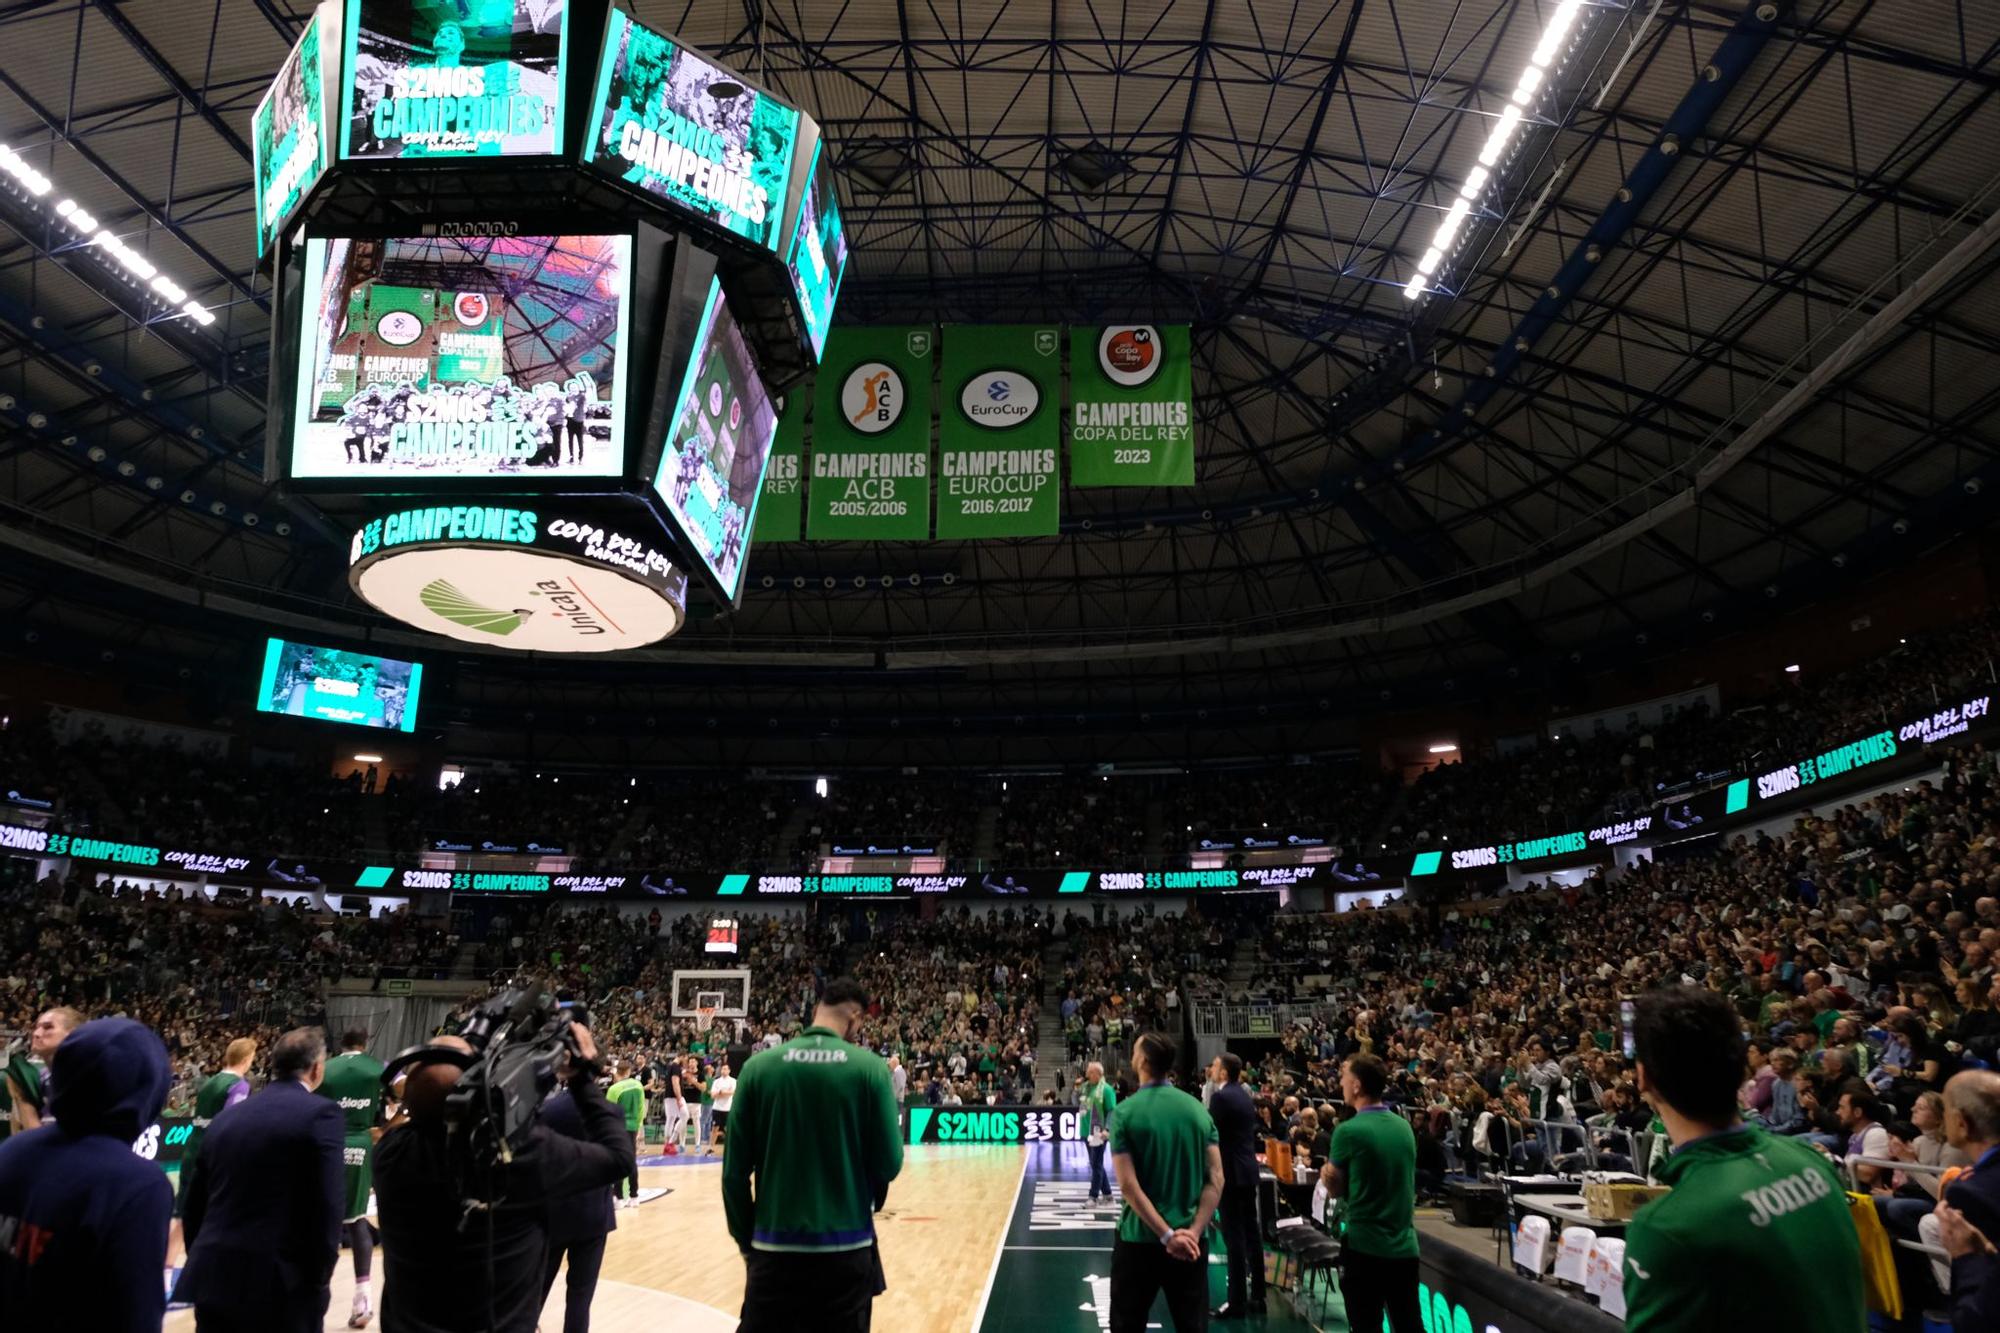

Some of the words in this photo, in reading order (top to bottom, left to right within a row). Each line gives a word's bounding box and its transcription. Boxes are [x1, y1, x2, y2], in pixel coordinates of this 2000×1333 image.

[393, 66, 485, 98] S2MOS
[373, 95, 544, 139] CAMPEONES
[643, 100, 725, 165] S2MOS
[619, 119, 768, 225] CAMPEONES
[440, 221, 519, 237] MONDO
[367, 372, 424, 383] EUROCUP
[406, 395, 487, 423] S2MOS
[971, 404, 1028, 416] EuroCup
[1075, 402, 1188, 426] CAMPEONES
[388, 421, 538, 459] CAMPEONES
[1074, 427, 1117, 440] COPA
[1121, 427, 1153, 440] DEL
[1157, 426, 1190, 440] REY
[814, 453, 926, 478] CAMPEONES
[943, 449, 1055, 477] CAMPEONES
[1114, 449, 1151, 463] 2023
[766, 479, 798, 494] REY
[844, 479, 895, 499] ACB
[949, 474, 1047, 495] EUROCUP
[829, 501, 907, 516] 2005/2006
[961, 497, 1033, 514] 2016/2017
[383, 506, 538, 546] CAMPEONES
[548, 519, 604, 547] COPA
[607, 532, 645, 559] DEL
[645, 549, 673, 577] REY
[584, 544, 649, 577] BADALONA
[529, 579, 606, 636] Unicaja
[1900, 718, 1931, 741] COPA
[1933, 708, 1960, 728] DEL
[1962, 697, 1990, 719] REY
[1757, 765, 1799, 799] S2MOS
[1816, 730, 1897, 779] CAMPEONES
[1589, 827, 1613, 841] COPA
[1614, 823, 1632, 836] DEL
[1633, 817, 1652, 830] REY
[0, 825, 48, 851] S2MOS
[71, 838, 160, 866] CAMPEONES
[1452, 847, 1497, 869] S2MOS
[1515, 831, 1587, 861] CAMPEONES
[164, 852, 197, 864] COPA
[198, 855, 223, 866] DEL
[225, 858, 250, 870] REY
[403, 871, 451, 889] S2MOS
[473, 874, 550, 891] CAMPEONES
[554, 877, 583, 887] COPA
[583, 877, 605, 887] DEL
[605, 877, 626, 888] REY
[758, 876, 802, 893] S2MOS
[821, 876, 893, 893] CAMPEONES
[897, 878, 923, 887] COPA
[924, 877, 945, 886] DEL
[946, 877, 967, 887] REY
[1100, 873, 1144, 890] S2MOS
[1164, 871, 1238, 888] CAMPEONES
[1242, 870, 1269, 880] COPA
[1270, 869, 1292, 880] DEL
[1293, 867, 1316, 878] REY
[708, 929, 729, 943] 24
[937, 1112, 1019, 1140] S2MOS
